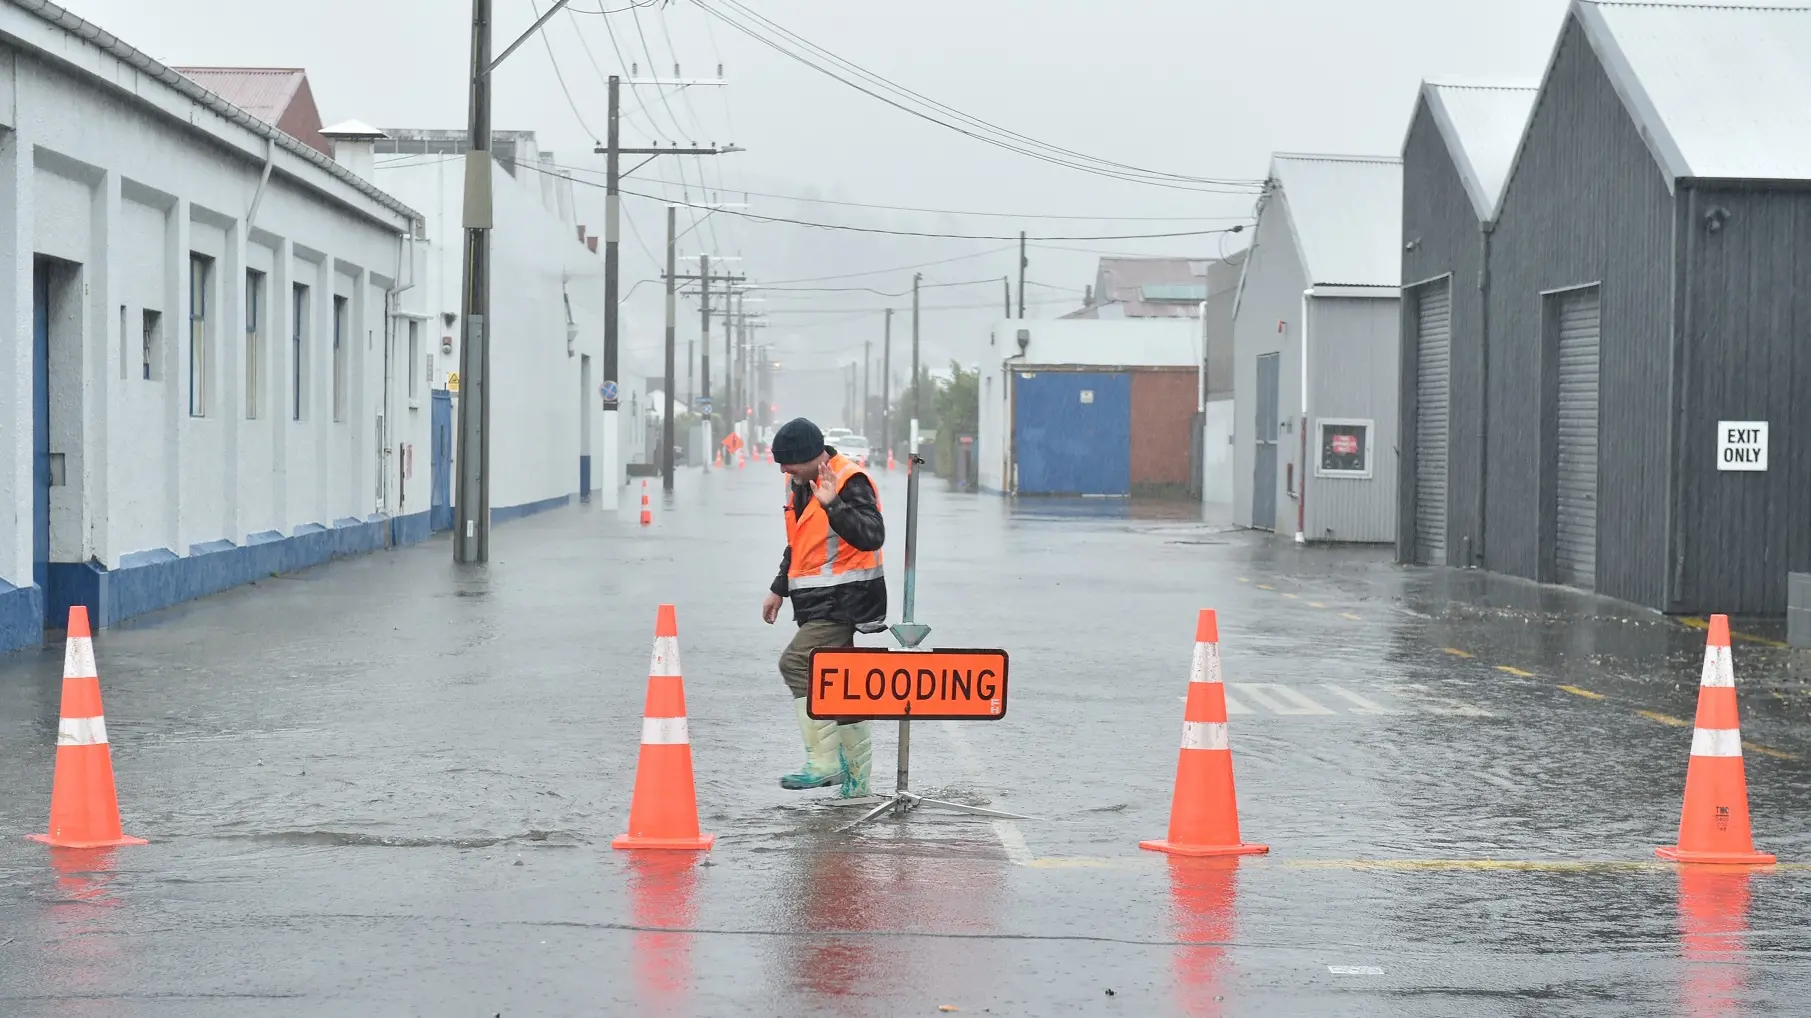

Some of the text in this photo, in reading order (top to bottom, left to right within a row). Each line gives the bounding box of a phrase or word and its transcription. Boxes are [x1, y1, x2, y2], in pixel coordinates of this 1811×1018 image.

[1727, 429, 1760, 444] EXIT
[1724, 447, 1761, 463] ONLY
[819, 668, 996, 700] FLOODING
